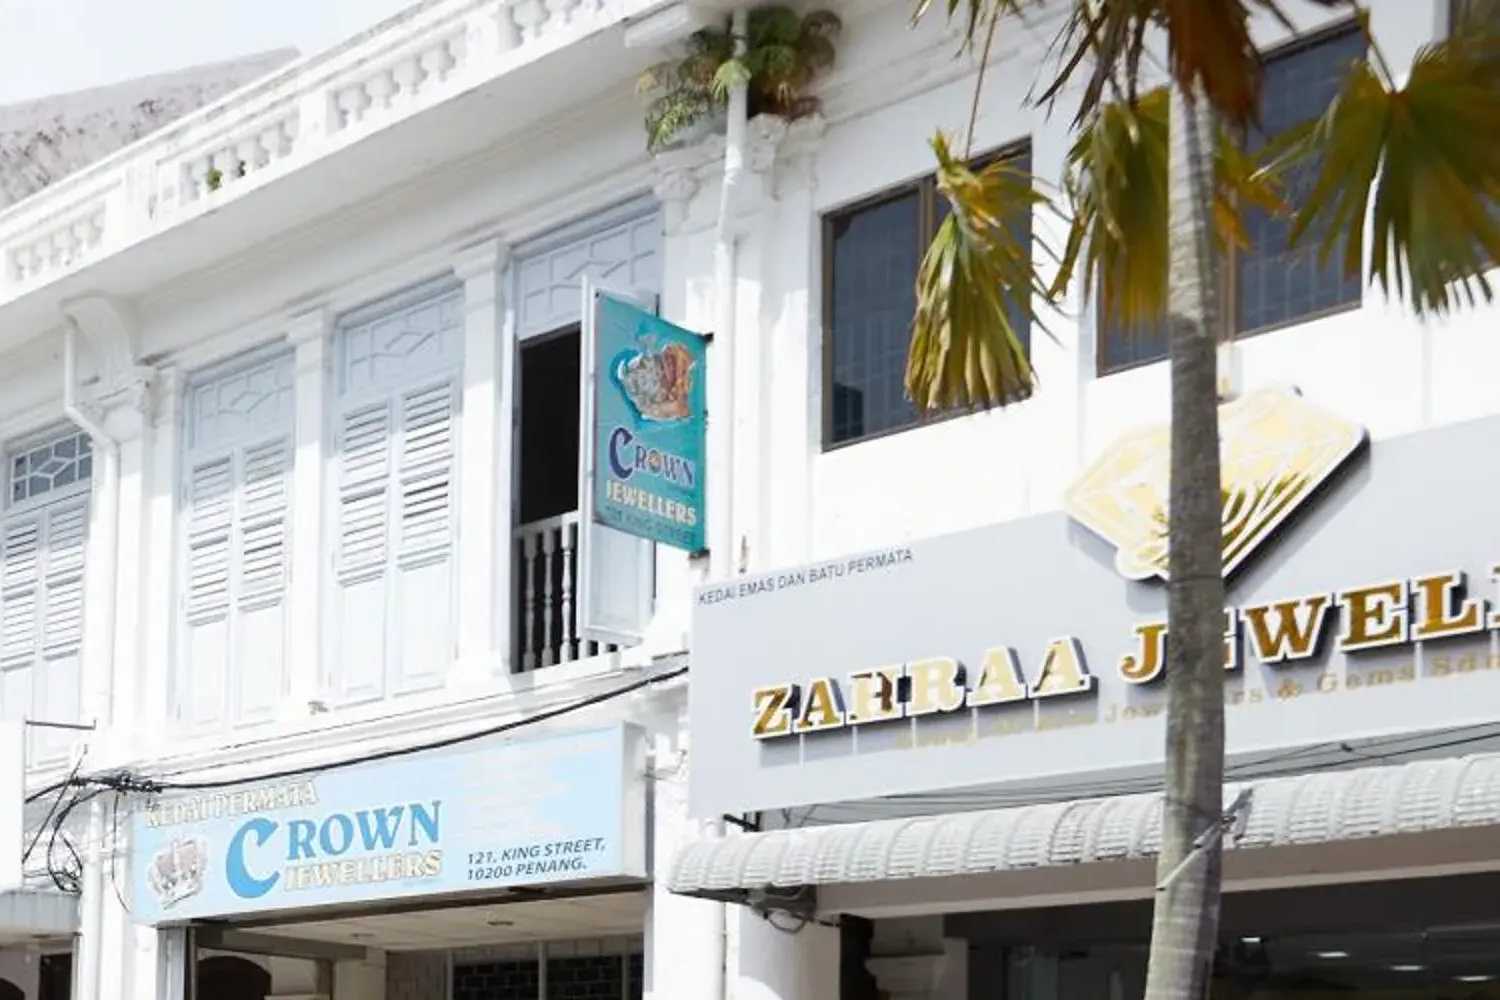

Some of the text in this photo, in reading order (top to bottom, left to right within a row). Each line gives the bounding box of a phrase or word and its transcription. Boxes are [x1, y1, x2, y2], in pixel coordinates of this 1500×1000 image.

[609, 427, 696, 487] CROWN
[606, 480, 696, 526] JEWELLERS
[699, 548, 913, 606] KEDAI EMAS DAN BATU PERMATA
[750, 561, 1500, 740] ZAHRAA JWEL
[1316, 663, 1416, 693] Gems
[211, 780, 320, 817] PERMATA
[226, 799, 442, 899] CROWN
[284, 850, 443, 892] JEWELLERS
[501, 844, 541, 862] KING
[467, 864, 513, 881] 10200
